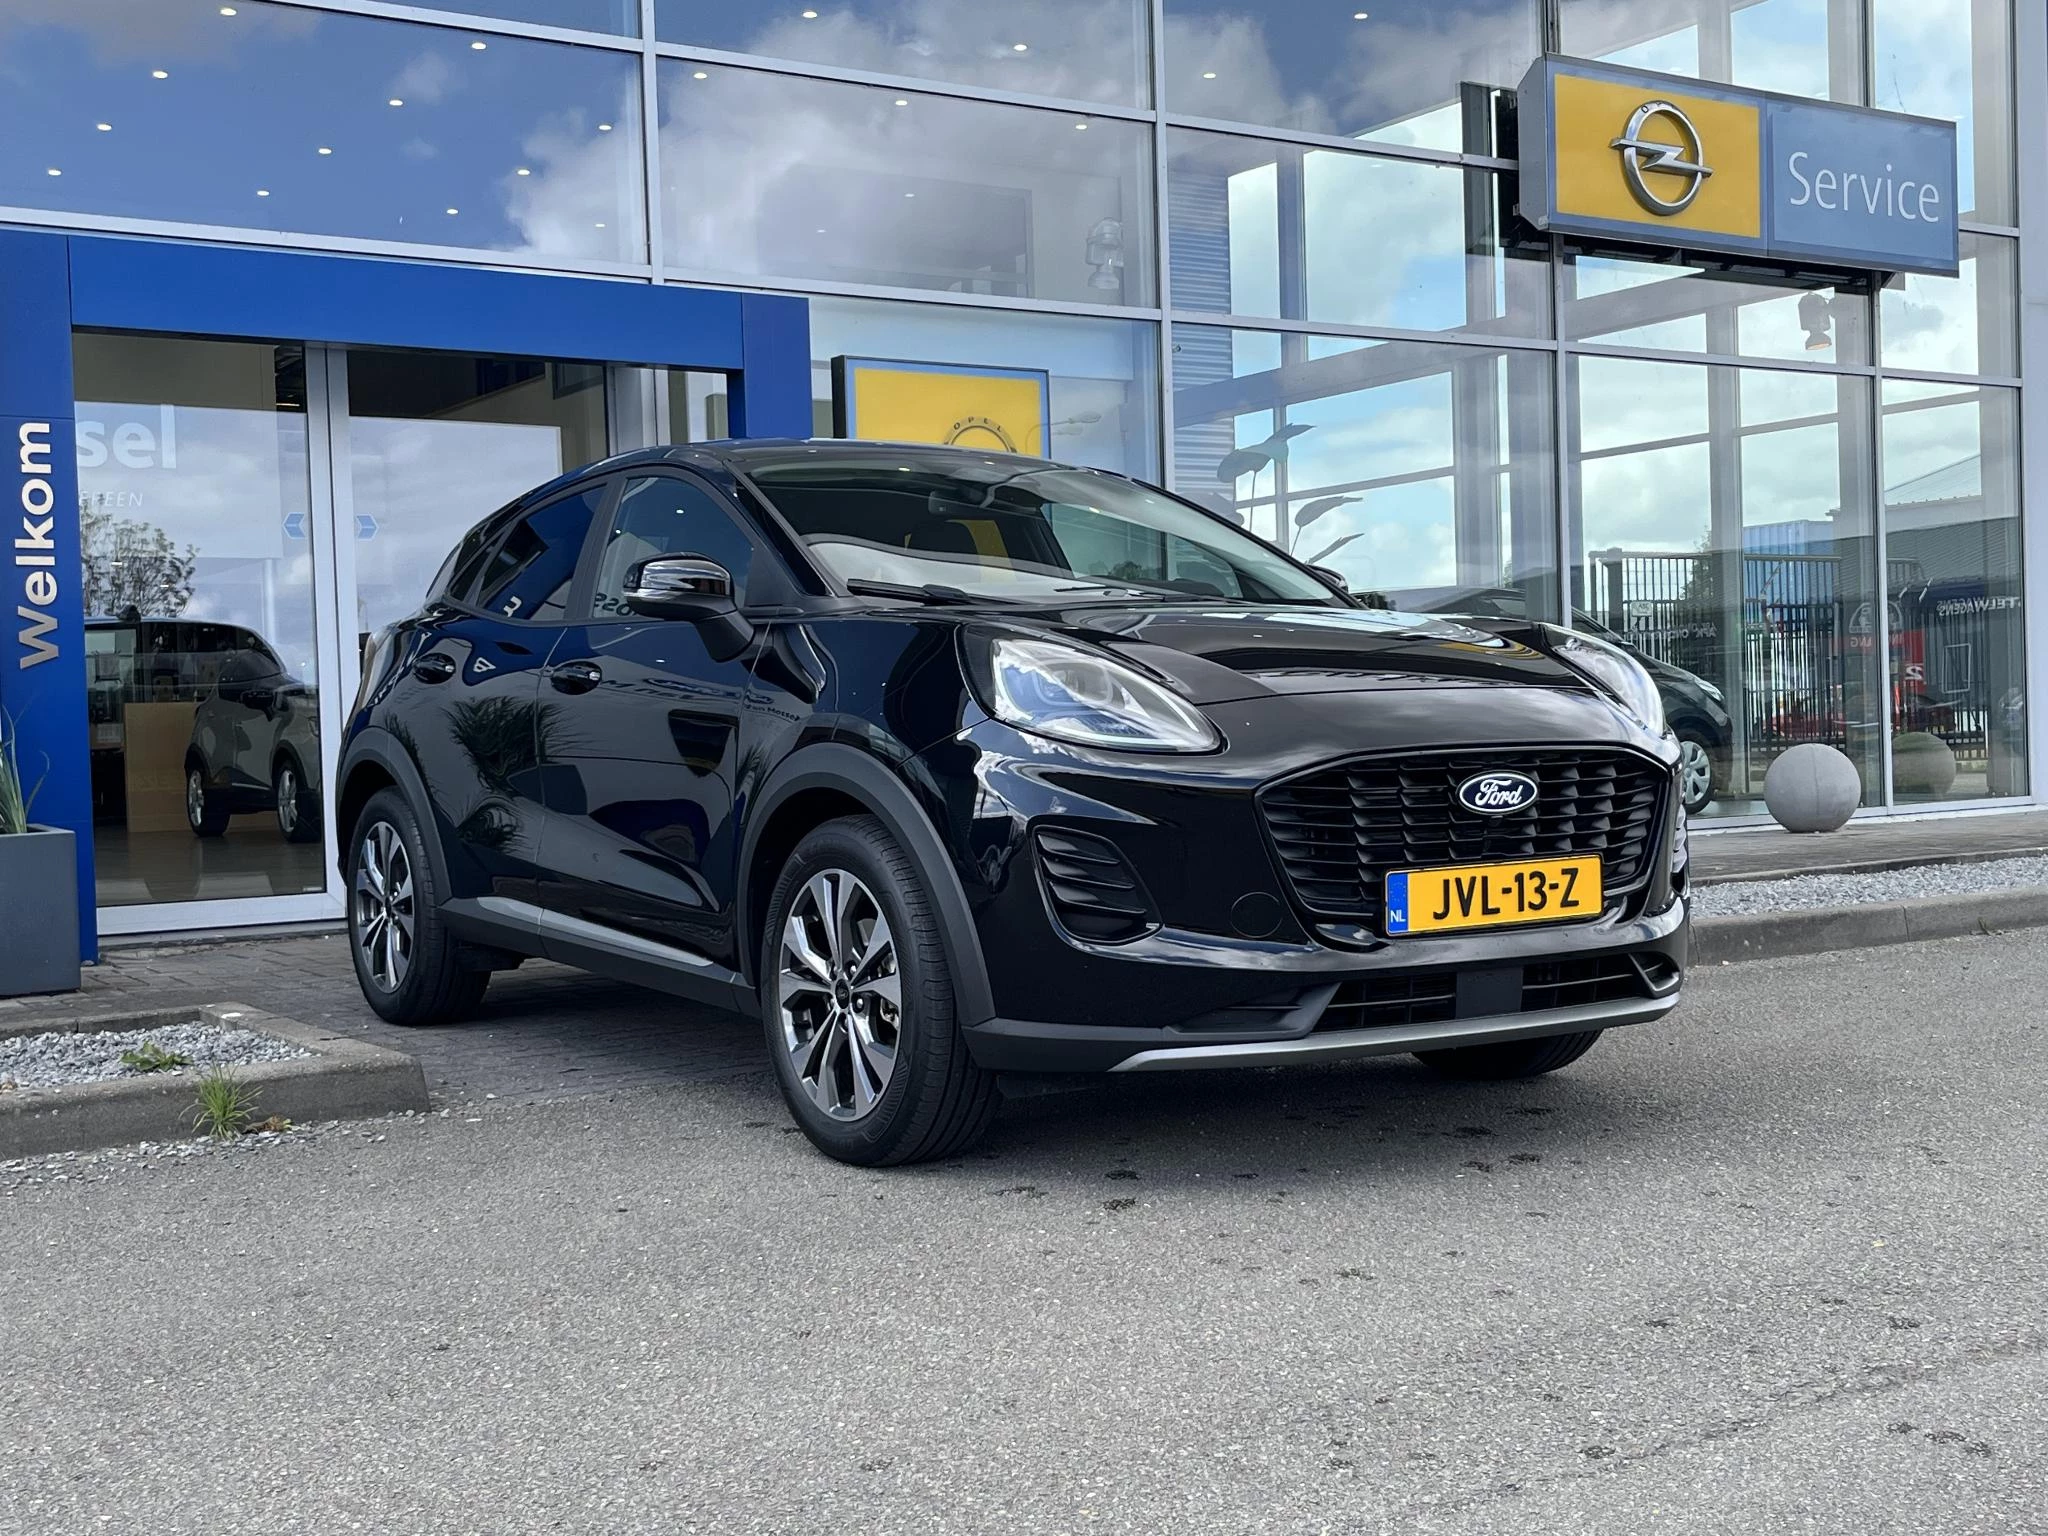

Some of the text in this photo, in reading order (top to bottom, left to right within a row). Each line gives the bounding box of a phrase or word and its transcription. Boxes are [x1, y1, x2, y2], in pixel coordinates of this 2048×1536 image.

[1790, 150, 1940, 224] Service
[14, 421, 61, 669] Welkom
[1474, 778, 1524, 805] Ford
[1390, 909, 1407, 923] NL
[1432, 867, 1580, 921] JVL-13-Z
